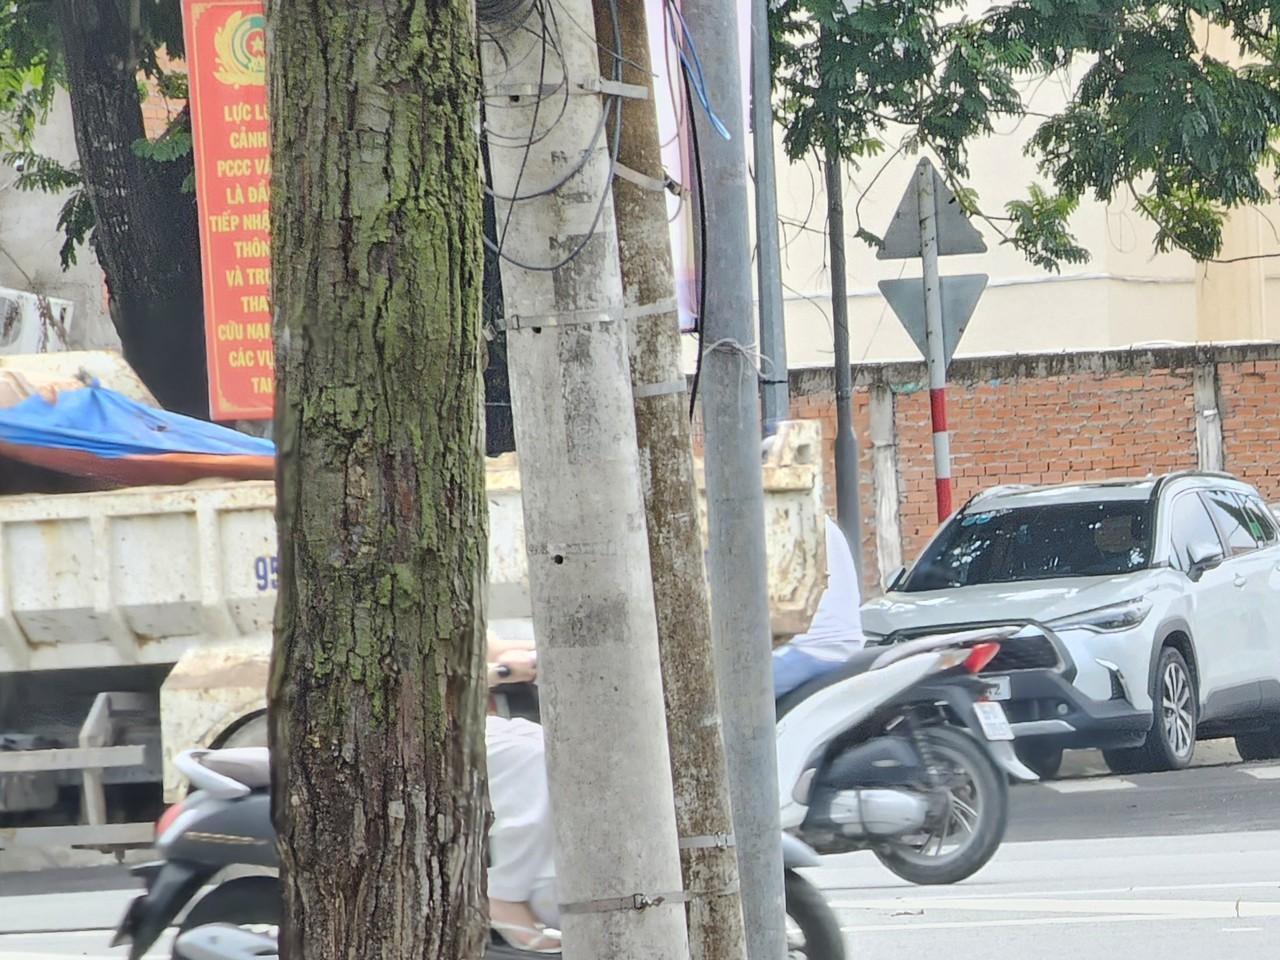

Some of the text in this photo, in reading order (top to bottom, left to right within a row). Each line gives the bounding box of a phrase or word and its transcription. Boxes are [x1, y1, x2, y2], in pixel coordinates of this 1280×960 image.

[224, 103, 252, 124] LỰC
[230, 127, 267, 149] CẢNH
[217, 160, 252, 178] PCCC
[227, 184, 244, 205] LÀ
[209, 210, 239, 232] TIẾP
[226, 265, 244, 288] VÀ
[229, 347, 254, 368] CÁC
